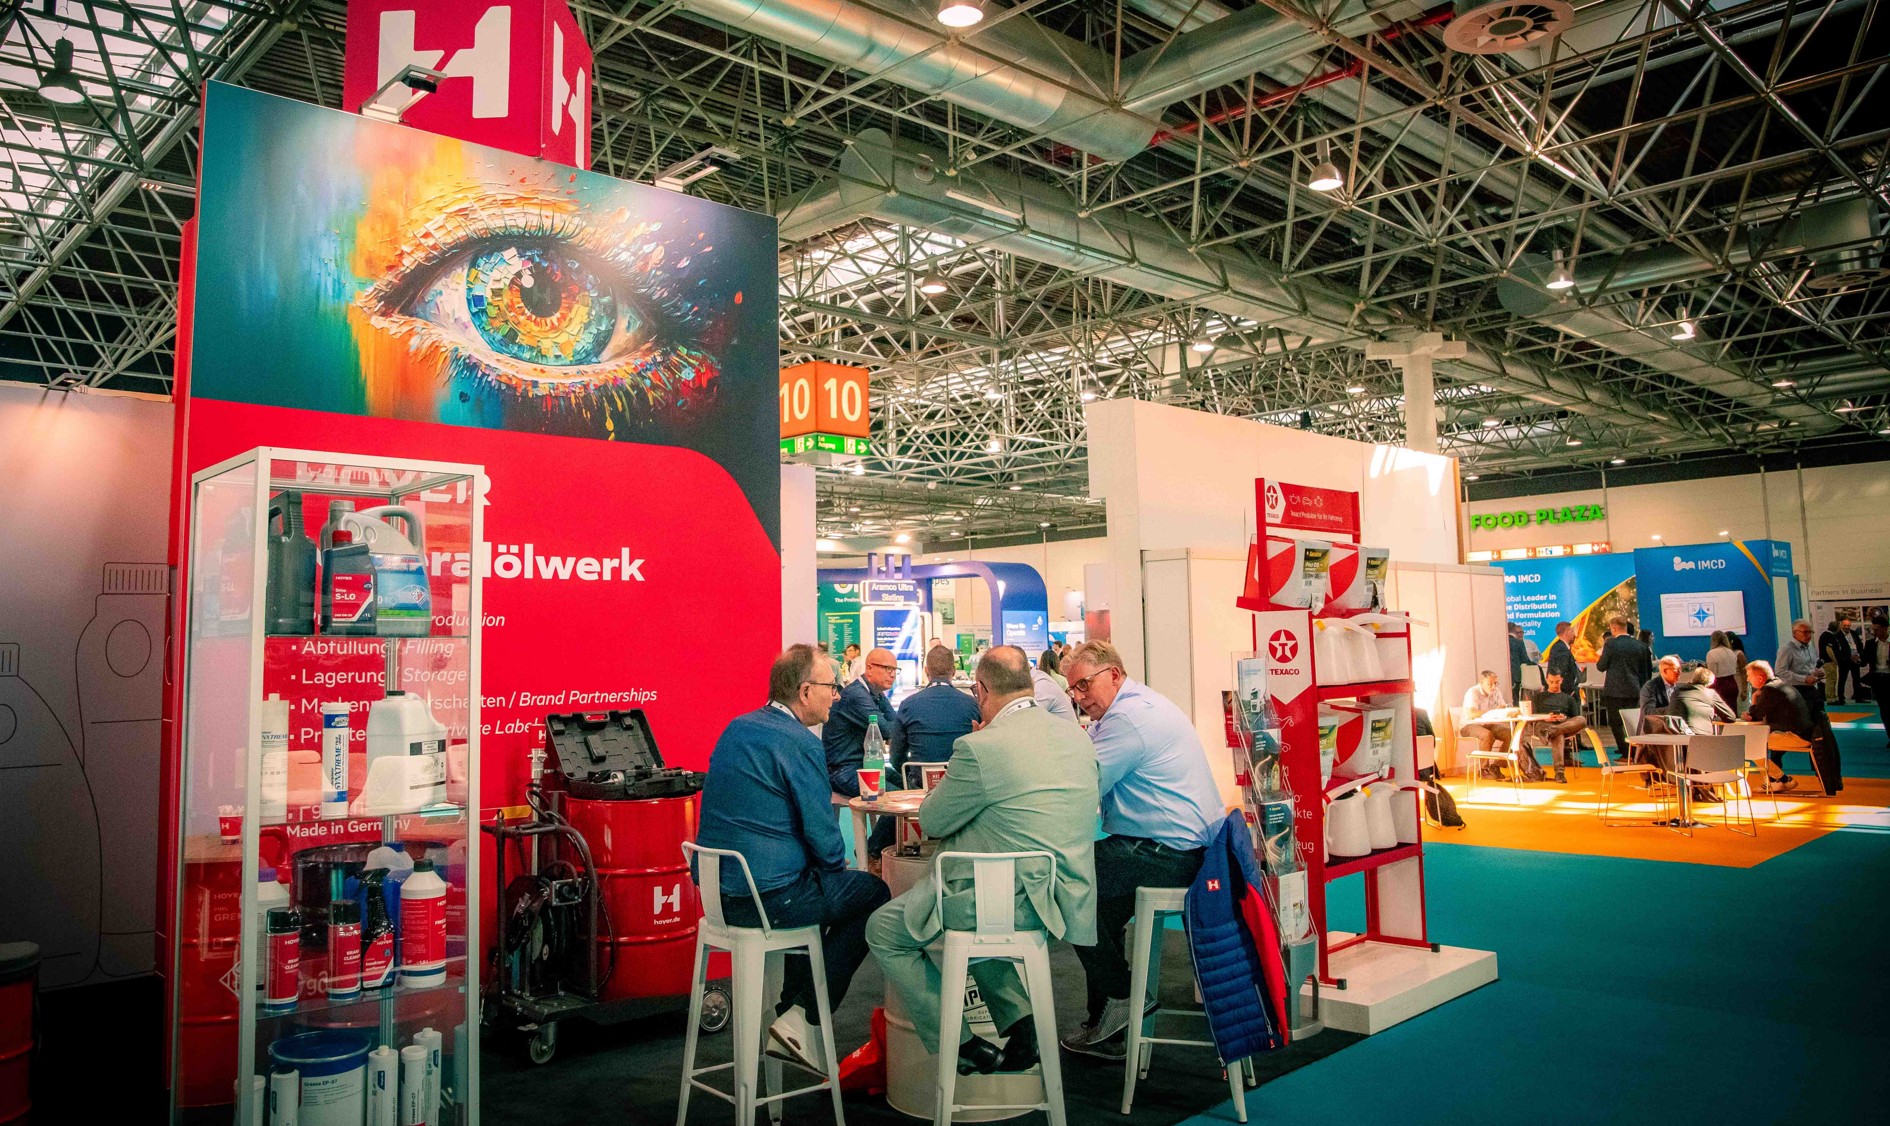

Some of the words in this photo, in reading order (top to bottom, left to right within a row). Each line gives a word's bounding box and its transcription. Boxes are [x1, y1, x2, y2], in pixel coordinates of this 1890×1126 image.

[779, 377, 811, 423] 10
[823, 377, 862, 422] 10
[1471, 510, 1529, 530] FOOD
[1536, 504, 1603, 525] PLAZA
[424, 542, 646, 581] ralölwerk
[1698, 559, 1726, 570] IMCD
[1518, 573, 1541, 583] IMCD
[335, 593, 356, 601] S-LO
[1506, 594, 1521, 602] obal
[1522, 594, 1547, 602] Leader
[1514, 602, 1557, 611] Distribution
[431, 612, 505, 627] roduion
[1515, 611, 1560, 619] Formulation
[405, 640, 455, 658] Filling
[403, 667, 467, 684] Storage
[1270, 668, 1300, 676] TEXACO
[518, 689, 566, 707] Brand
[568, 688, 658, 706] Partnerships
[287, 823, 327, 838] Made
[331, 822, 344, 835] in
[347, 817, 411, 834] Germny
[653, 916, 681, 925] hoyer.de
